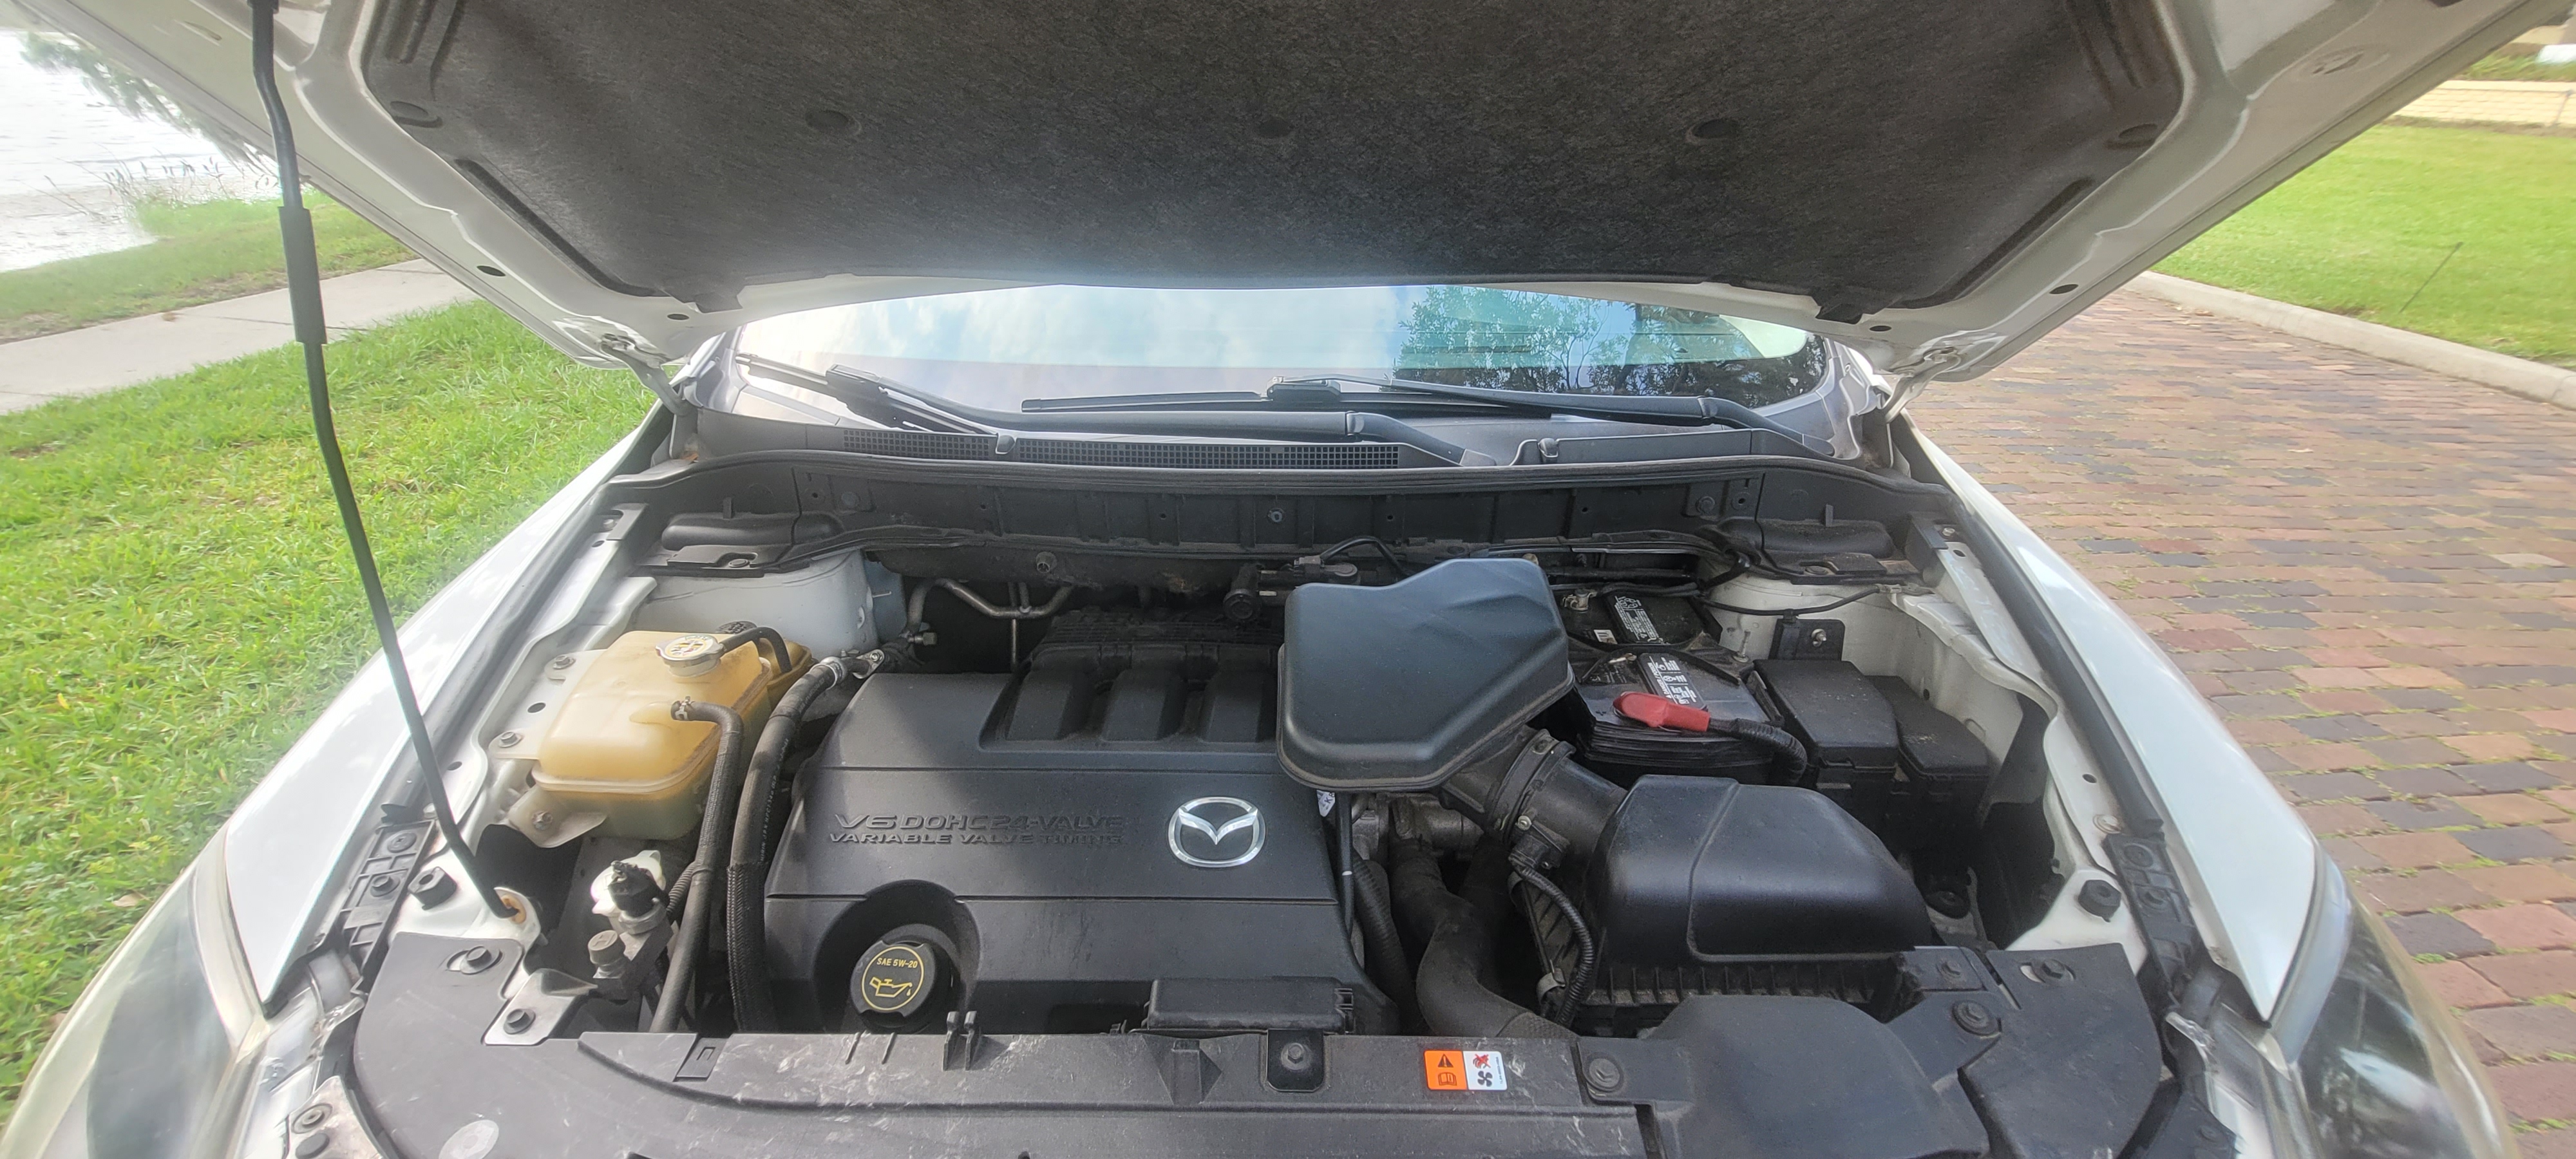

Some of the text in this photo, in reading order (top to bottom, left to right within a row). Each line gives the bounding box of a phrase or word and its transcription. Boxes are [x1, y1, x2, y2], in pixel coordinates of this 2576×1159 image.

[835, 813, 1124, 831] V6 DOHC 24-VALVE
[830, 833, 1124, 845] VARIABLE VALVE TIMING
[876, 957, 918, 968] SAE 5W-20
